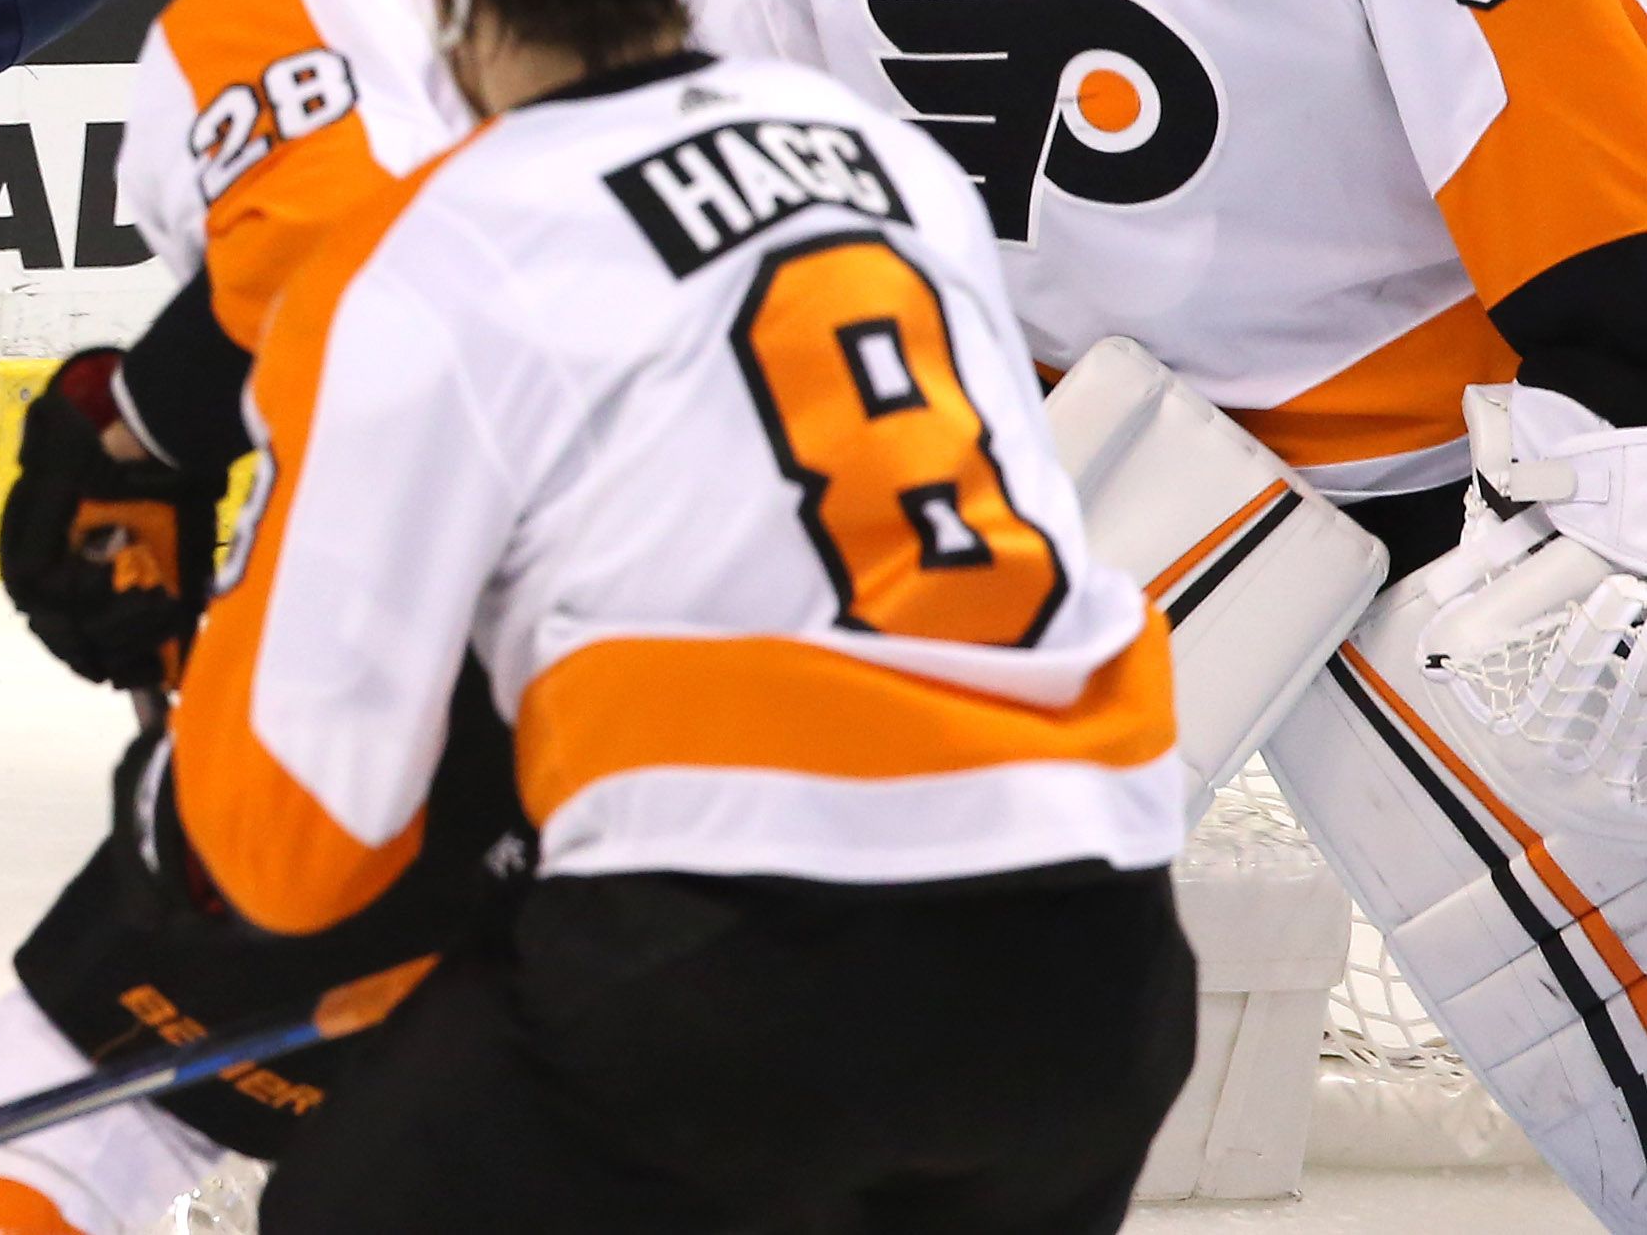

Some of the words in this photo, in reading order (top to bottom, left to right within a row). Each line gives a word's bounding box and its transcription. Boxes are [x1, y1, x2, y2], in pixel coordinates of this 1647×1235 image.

[192, 46, 360, 206] 28
[729, 228, 1071, 648] 8
[118, 983, 325, 1116] BAER
